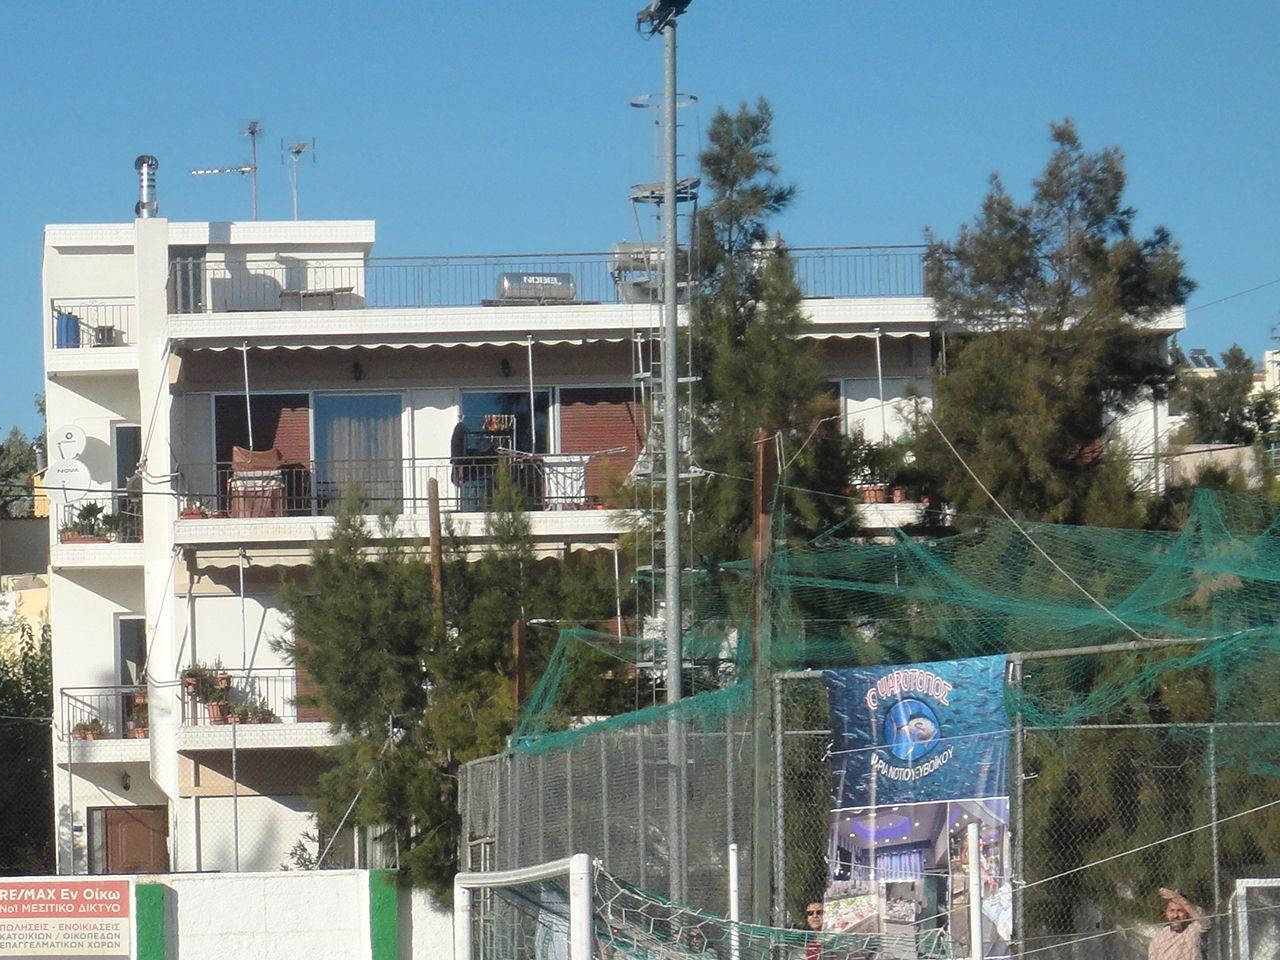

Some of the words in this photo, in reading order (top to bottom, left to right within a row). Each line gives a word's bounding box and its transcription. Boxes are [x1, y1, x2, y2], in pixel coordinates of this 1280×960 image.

[0, 888, 56, 901] RE/MAX
[82, 887, 121, 901] Οίκω
[21, 904, 75, 914] ΜΕΣΙΤΙΚΟ
[78, 903, 121, 913] ΔΙΚΤΥΟ
[0, 923, 49, 932] ΠΩΛΗΣΕΙΣ
[58, 923, 121, 932] ΕΝΟΙΚΙΑΣΕΙΣ
[0, 932, 52, 941] ΚΑΤΟΙΚΙΩΝ
[63, 932, 121, 941] ΟΙΚΟΠΕΔΩΝ
[0, 941, 84, 949] ΕΠΑΓΓΕΛΜΑΤΙΚΩΝ
[86, 941, 121, 949] ΧΩΡΩΝ
